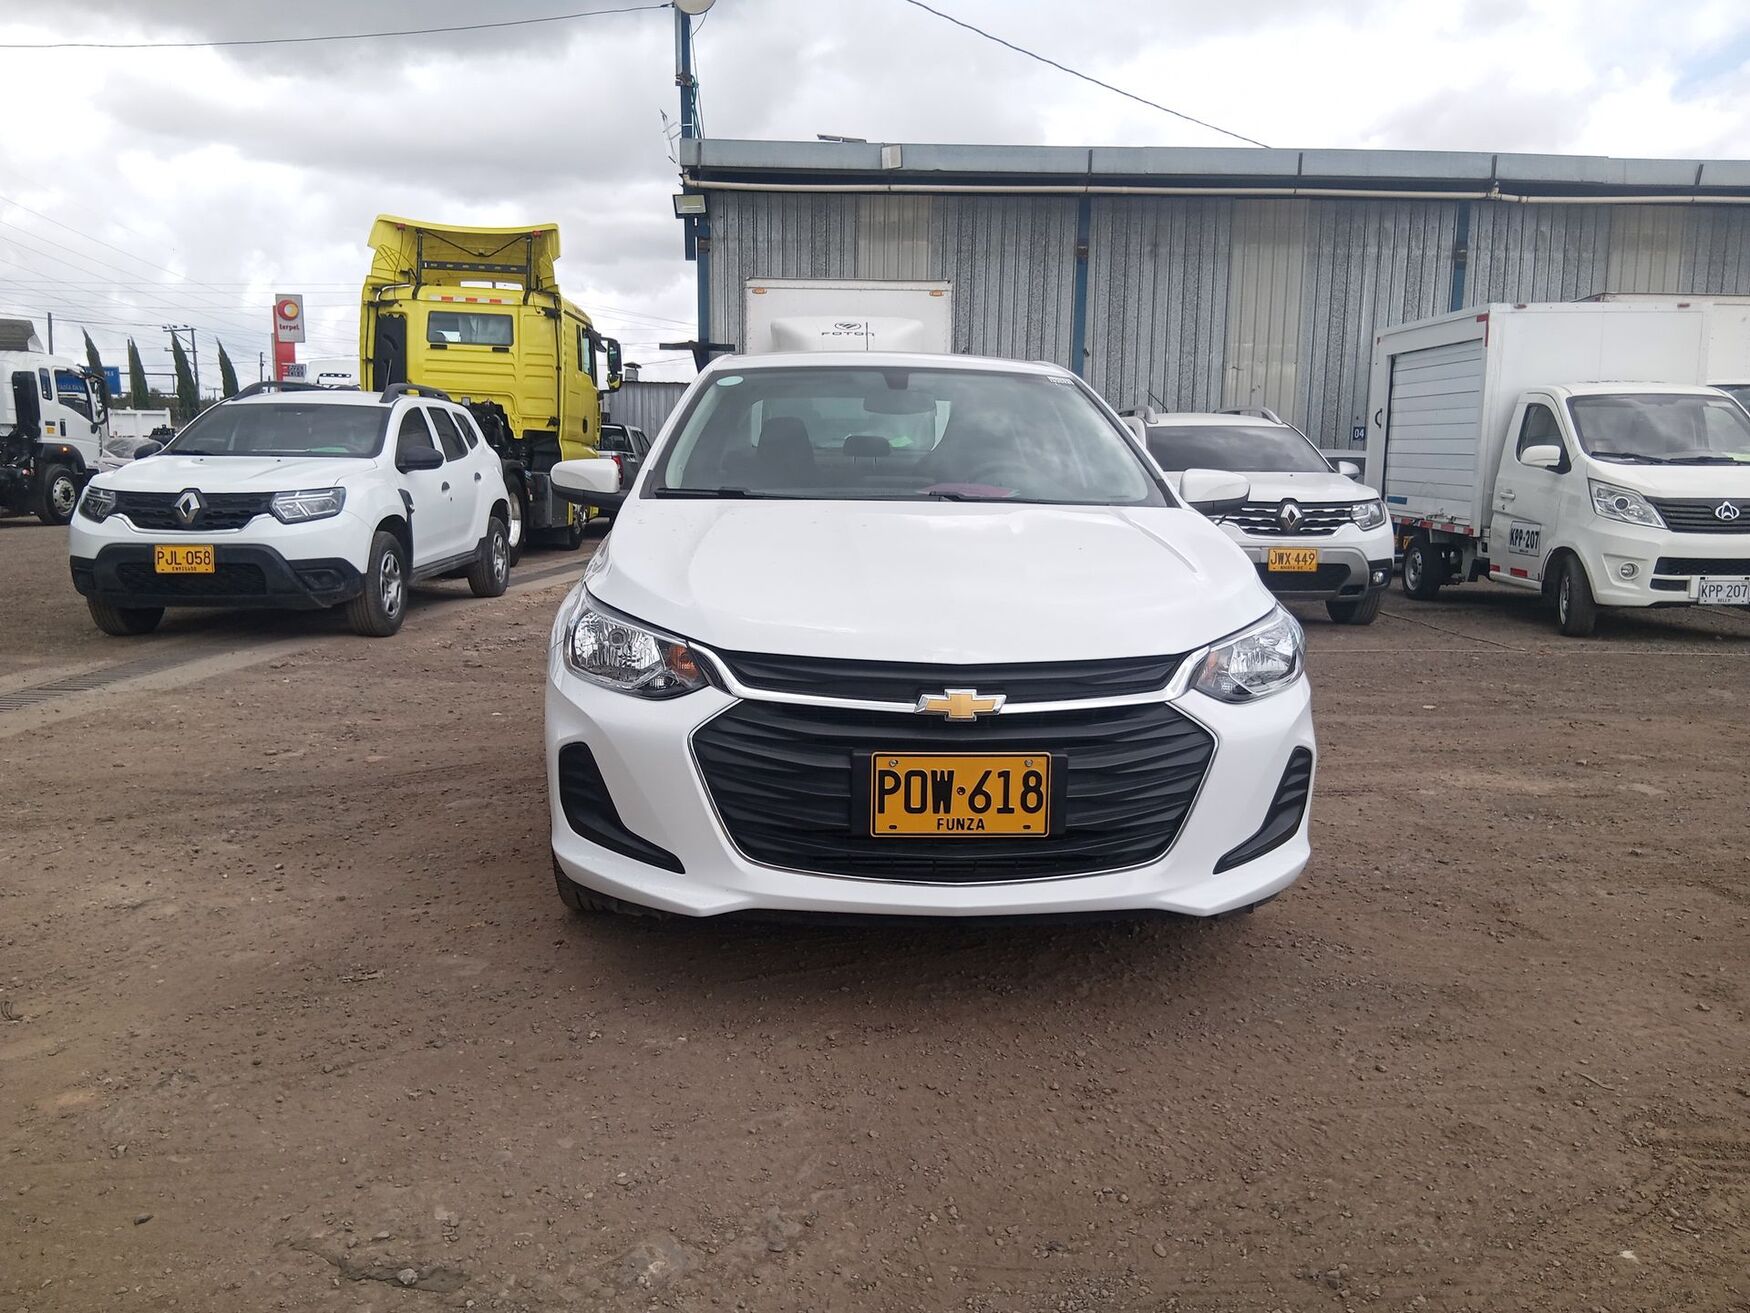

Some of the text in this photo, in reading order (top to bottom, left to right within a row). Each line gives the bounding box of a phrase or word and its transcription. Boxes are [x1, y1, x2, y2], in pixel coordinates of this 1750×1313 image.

[279, 323, 300, 331] terpel
[1354, 428, 1365, 439] 04
[1270, 550, 1316, 566] JWX 449
[1701, 584, 1748, 598] KPP 207
[936, 817, 985, 831] FUNZA
